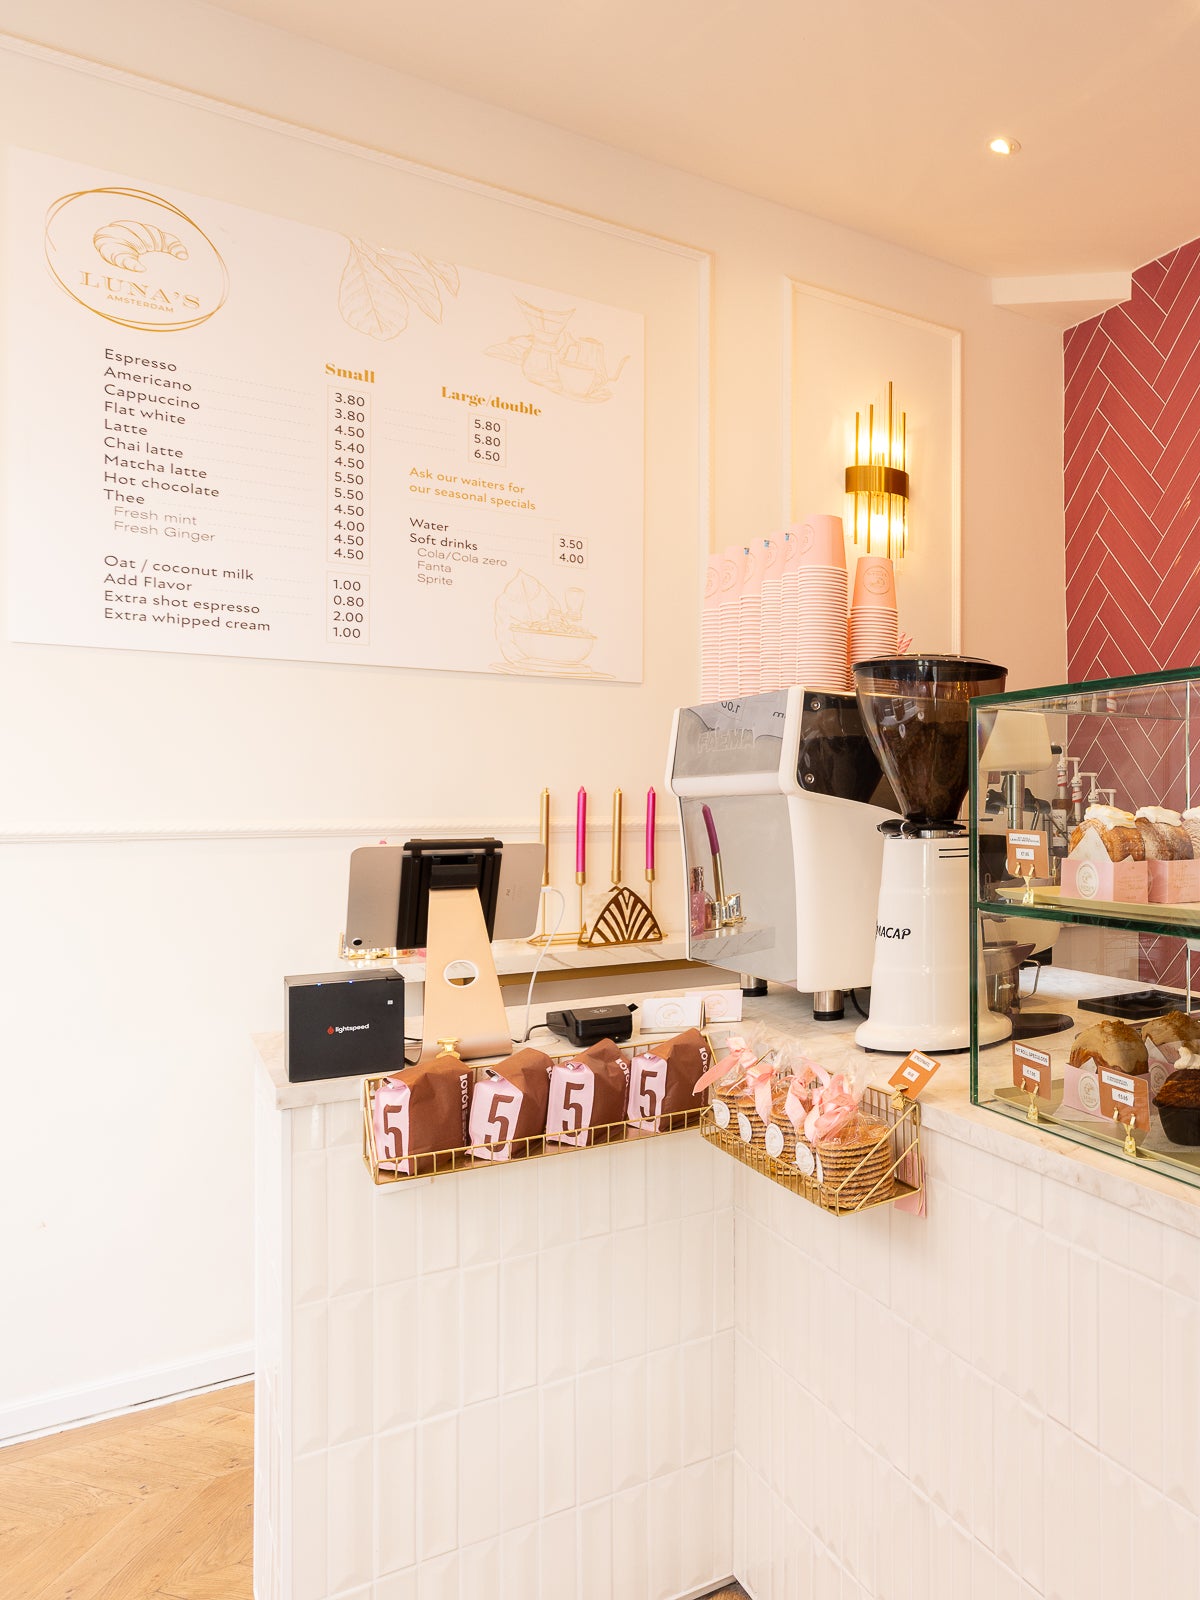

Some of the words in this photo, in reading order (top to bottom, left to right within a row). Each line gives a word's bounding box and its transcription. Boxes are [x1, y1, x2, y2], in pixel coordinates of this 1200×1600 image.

[80, 271, 200, 309] LUNA'S
[107, 294, 174, 313] AMSTERDAM
[104, 348, 177, 372] Espresso
[103, 367, 192, 392] Americano
[325, 363, 375, 384] Small
[104, 384, 200, 410] Cappuccino
[334, 392, 365, 407] 3.80
[441, 386, 542, 417] Large/double
[104, 401, 135, 417] Flat
[140, 409, 186, 425] white
[334, 408, 365, 423] 3.80
[104, 419, 148, 436] Latte
[334, 424, 365, 439] 4.50
[474, 419, 501, 433] 5.80
[104, 437, 140, 452] Chai
[146, 442, 184, 459] latte
[334, 440, 365, 454] 5.40
[474, 434, 501, 447] 5.80
[334, 456, 365, 470] 4.50
[474, 449, 501, 462] 6.50
[104, 454, 165, 473] Matcha
[170, 463, 207, 479] latte
[104, 471, 136, 486] Hot
[141, 478, 220, 497] chocolate
[334, 471, 364, 485] 5.50
[409, 467, 433, 480] Ask
[436, 473, 458, 483] our
[461, 475, 505, 491] waiters
[508, 482, 525, 494] for
[103, 489, 145, 505] Thee
[334, 487, 364, 501] 5.50
[409, 484, 431, 494] our
[434, 487, 487, 503] seasonal
[490, 495, 536, 511] specials
[114, 506, 158, 521] Fresh
[164, 514, 197, 526] mint
[334, 504, 364, 518] 4.50
[114, 520, 158, 535] Fresh
[164, 526, 216, 543] Ginger
[334, 520, 365, 533] 4.00
[409, 517, 449, 532] Water
[334, 534, 364, 547] 4.50
[409, 532, 436, 546] Soft
[440, 537, 478, 551] drinks
[559, 538, 583, 550] 3.50
[334, 548, 364, 561] 4.50
[417, 547, 479, 564] Cola/Cola
[483, 557, 508, 567] zero
[559, 553, 584, 565] 4.00
[104, 555, 136, 569] Oat
[141, 559, 148, 573] /
[153, 563, 218, 577] coconut
[223, 569, 254, 581] milk
[417, 561, 452, 573] Fanta
[104, 573, 138, 586] Add
[144, 577, 192, 591] Flavor
[333, 579, 361, 592] 1.00
[417, 573, 453, 587] Sprite
[104, 590, 147, 605] Extra
[152, 595, 188, 608] shot
[193, 600, 260, 614] espresso
[333, 595, 364, 608] 0.80
[104, 608, 147, 622] Extra
[152, 612, 220, 629] whipped
[225, 617, 270, 631] cream
[333, 611, 364, 623] 2.00
[333, 626, 361, 639] 1.00
[335, 1023, 370, 1034] lightspeed
[640, 1069, 658, 1122] 5
[562, 1082, 585, 1137] 5
[484, 1094, 515, 1153] 5
[383, 1104, 403, 1164] 5
